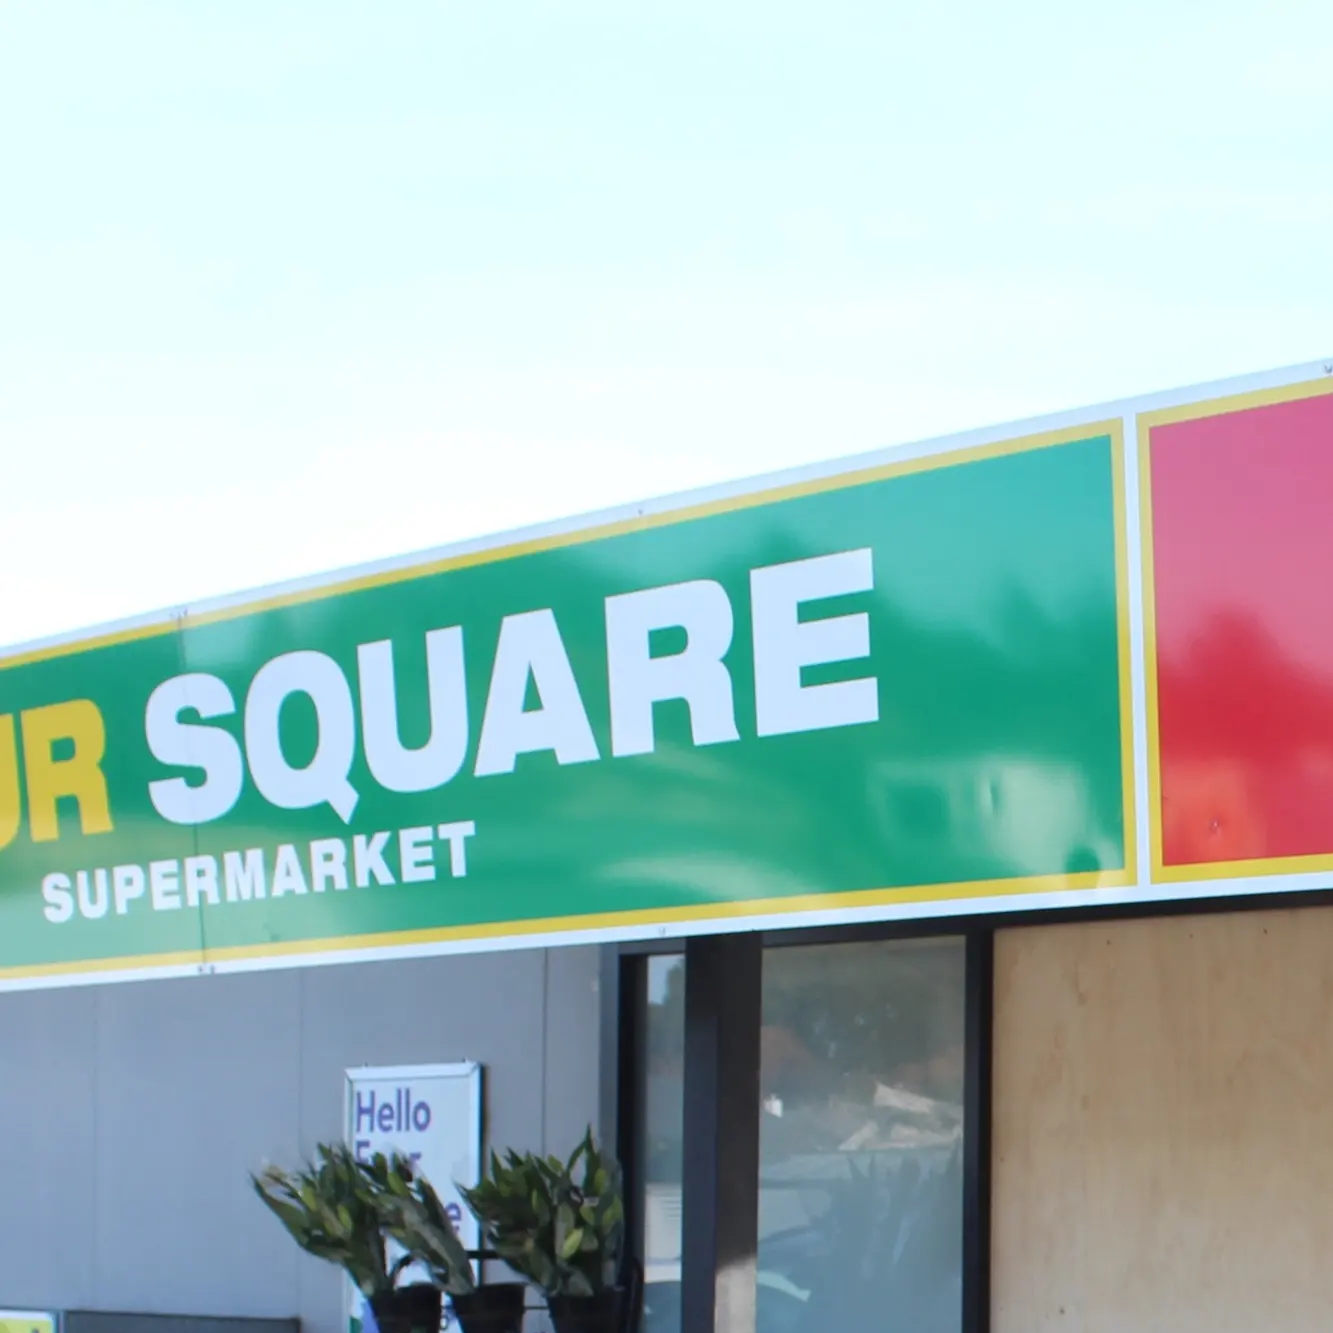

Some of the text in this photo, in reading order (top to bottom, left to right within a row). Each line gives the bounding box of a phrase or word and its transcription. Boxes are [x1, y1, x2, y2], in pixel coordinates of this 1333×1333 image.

[145, 547, 879, 824] SQUARE
[42, 820, 476, 923] SUPERMARKET
[356, 1087, 431, 1133] Hello
